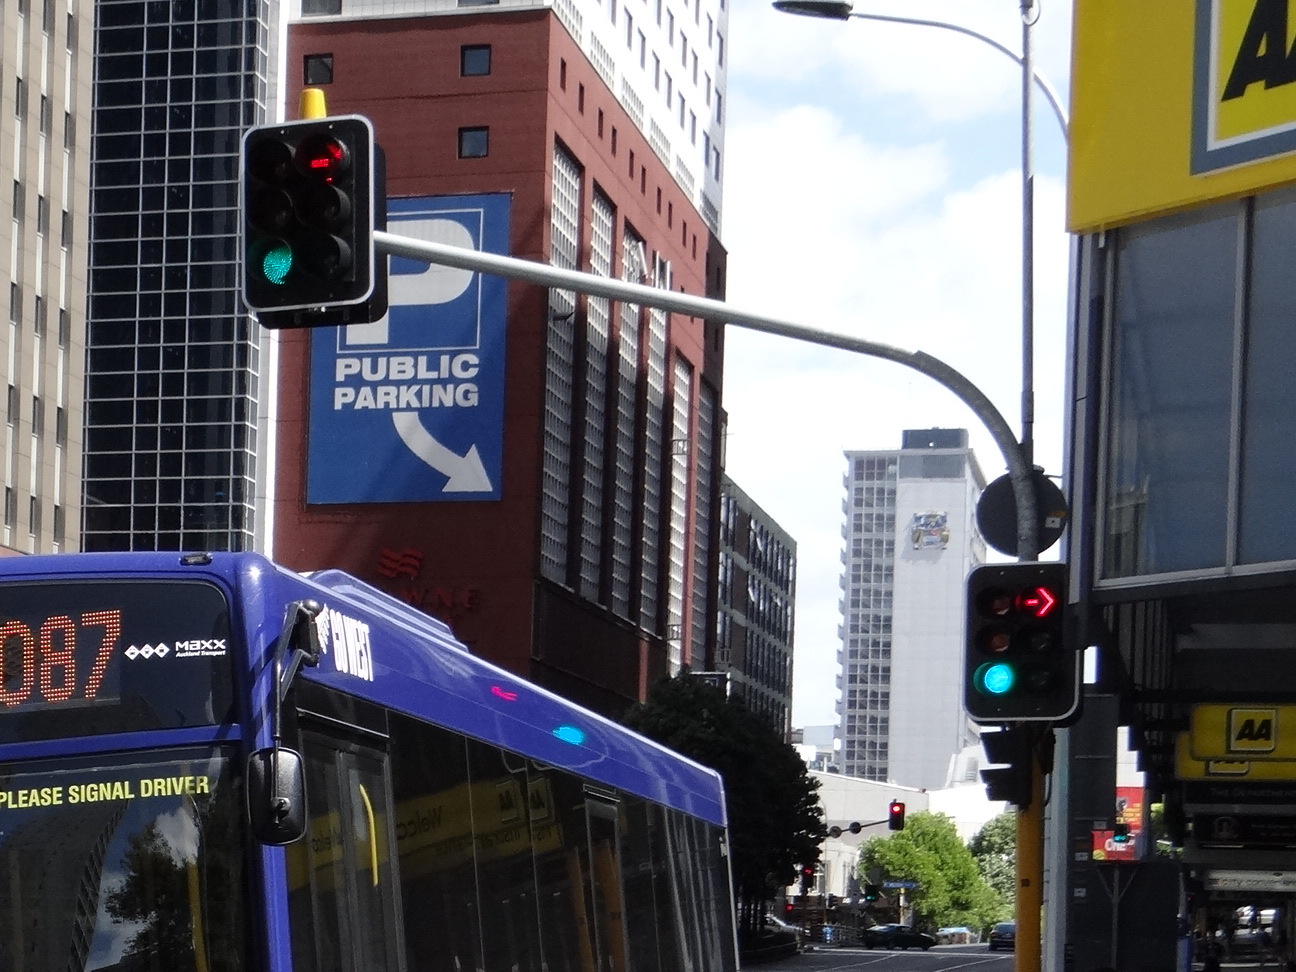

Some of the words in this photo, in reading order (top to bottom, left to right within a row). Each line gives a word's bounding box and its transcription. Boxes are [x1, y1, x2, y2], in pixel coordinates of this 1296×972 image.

[335, 353, 480, 382] PUBLIC
[334, 383, 479, 411] PARKING
[1236, 719, 1272, 741] AA
[68, 780, 135, 804] SIGNAL
[140, 775, 210, 799] DRIVER
